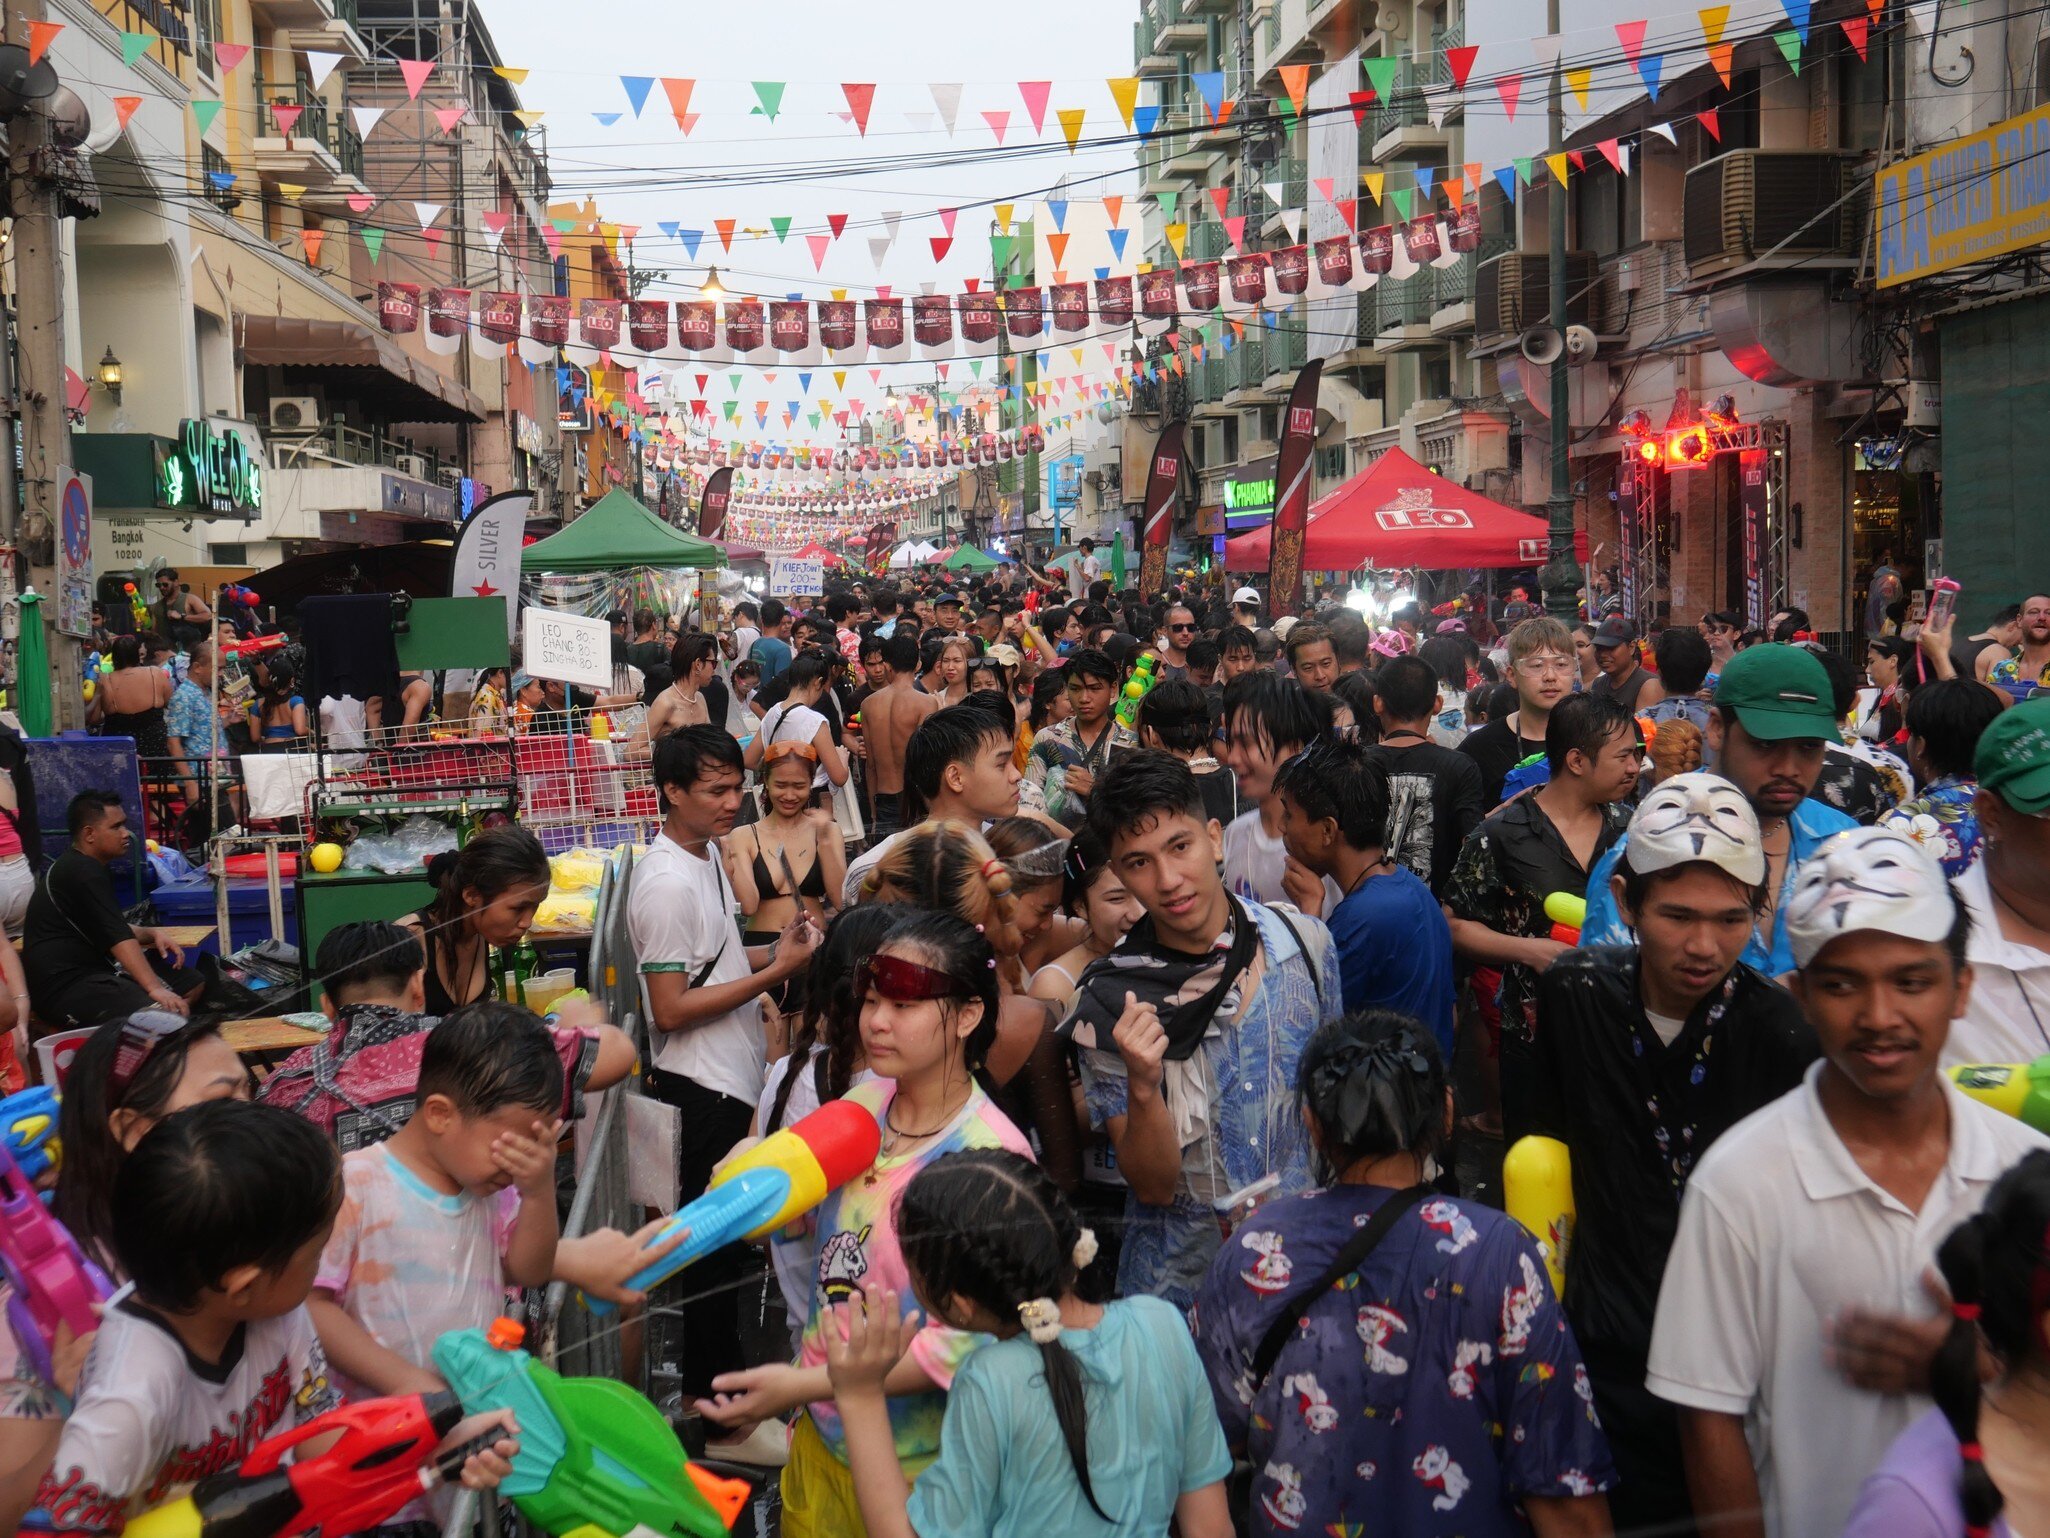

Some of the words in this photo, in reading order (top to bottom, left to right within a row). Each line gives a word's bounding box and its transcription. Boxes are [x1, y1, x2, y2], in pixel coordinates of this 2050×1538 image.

[1879, 165, 1930, 279] AA
[1931, 140, 1992, 237] SILVER
[1410, 234, 1434, 247] LEO
[1324, 255, 1347, 268] LEO
[1236, 274, 1260, 286] LEO
[1147, 289, 1170, 302] LEO
[385, 302, 411, 314] LEO
[1059, 302, 1083, 312] LEO
[488, 311, 513, 325] LEO
[588, 317, 613, 329] LEO
[873, 319, 897, 329] LEO
[967, 313, 990, 323] LEO
[684, 321, 708, 331] LEO
[777, 322, 802, 332] LEO
[1291, 409, 1312, 433] LEO
[1158, 458, 1176, 476] LEO
[1747, 472, 1761, 485] LEO
[1237, 481, 1267, 507] PHARMA
[1376, 510, 1471, 530] LEO
[112, 530, 144, 546] Bangkok
[478, 520, 500, 571] SILVER
[1521, 541, 1550, 561] LE
[115, 550, 142, 559] 10200
[791, 585, 809, 594] GET
[542, 624, 561, 637] LEO
[543, 637, 574, 652] CHANG
[543, 650, 577, 665] SINGHA
